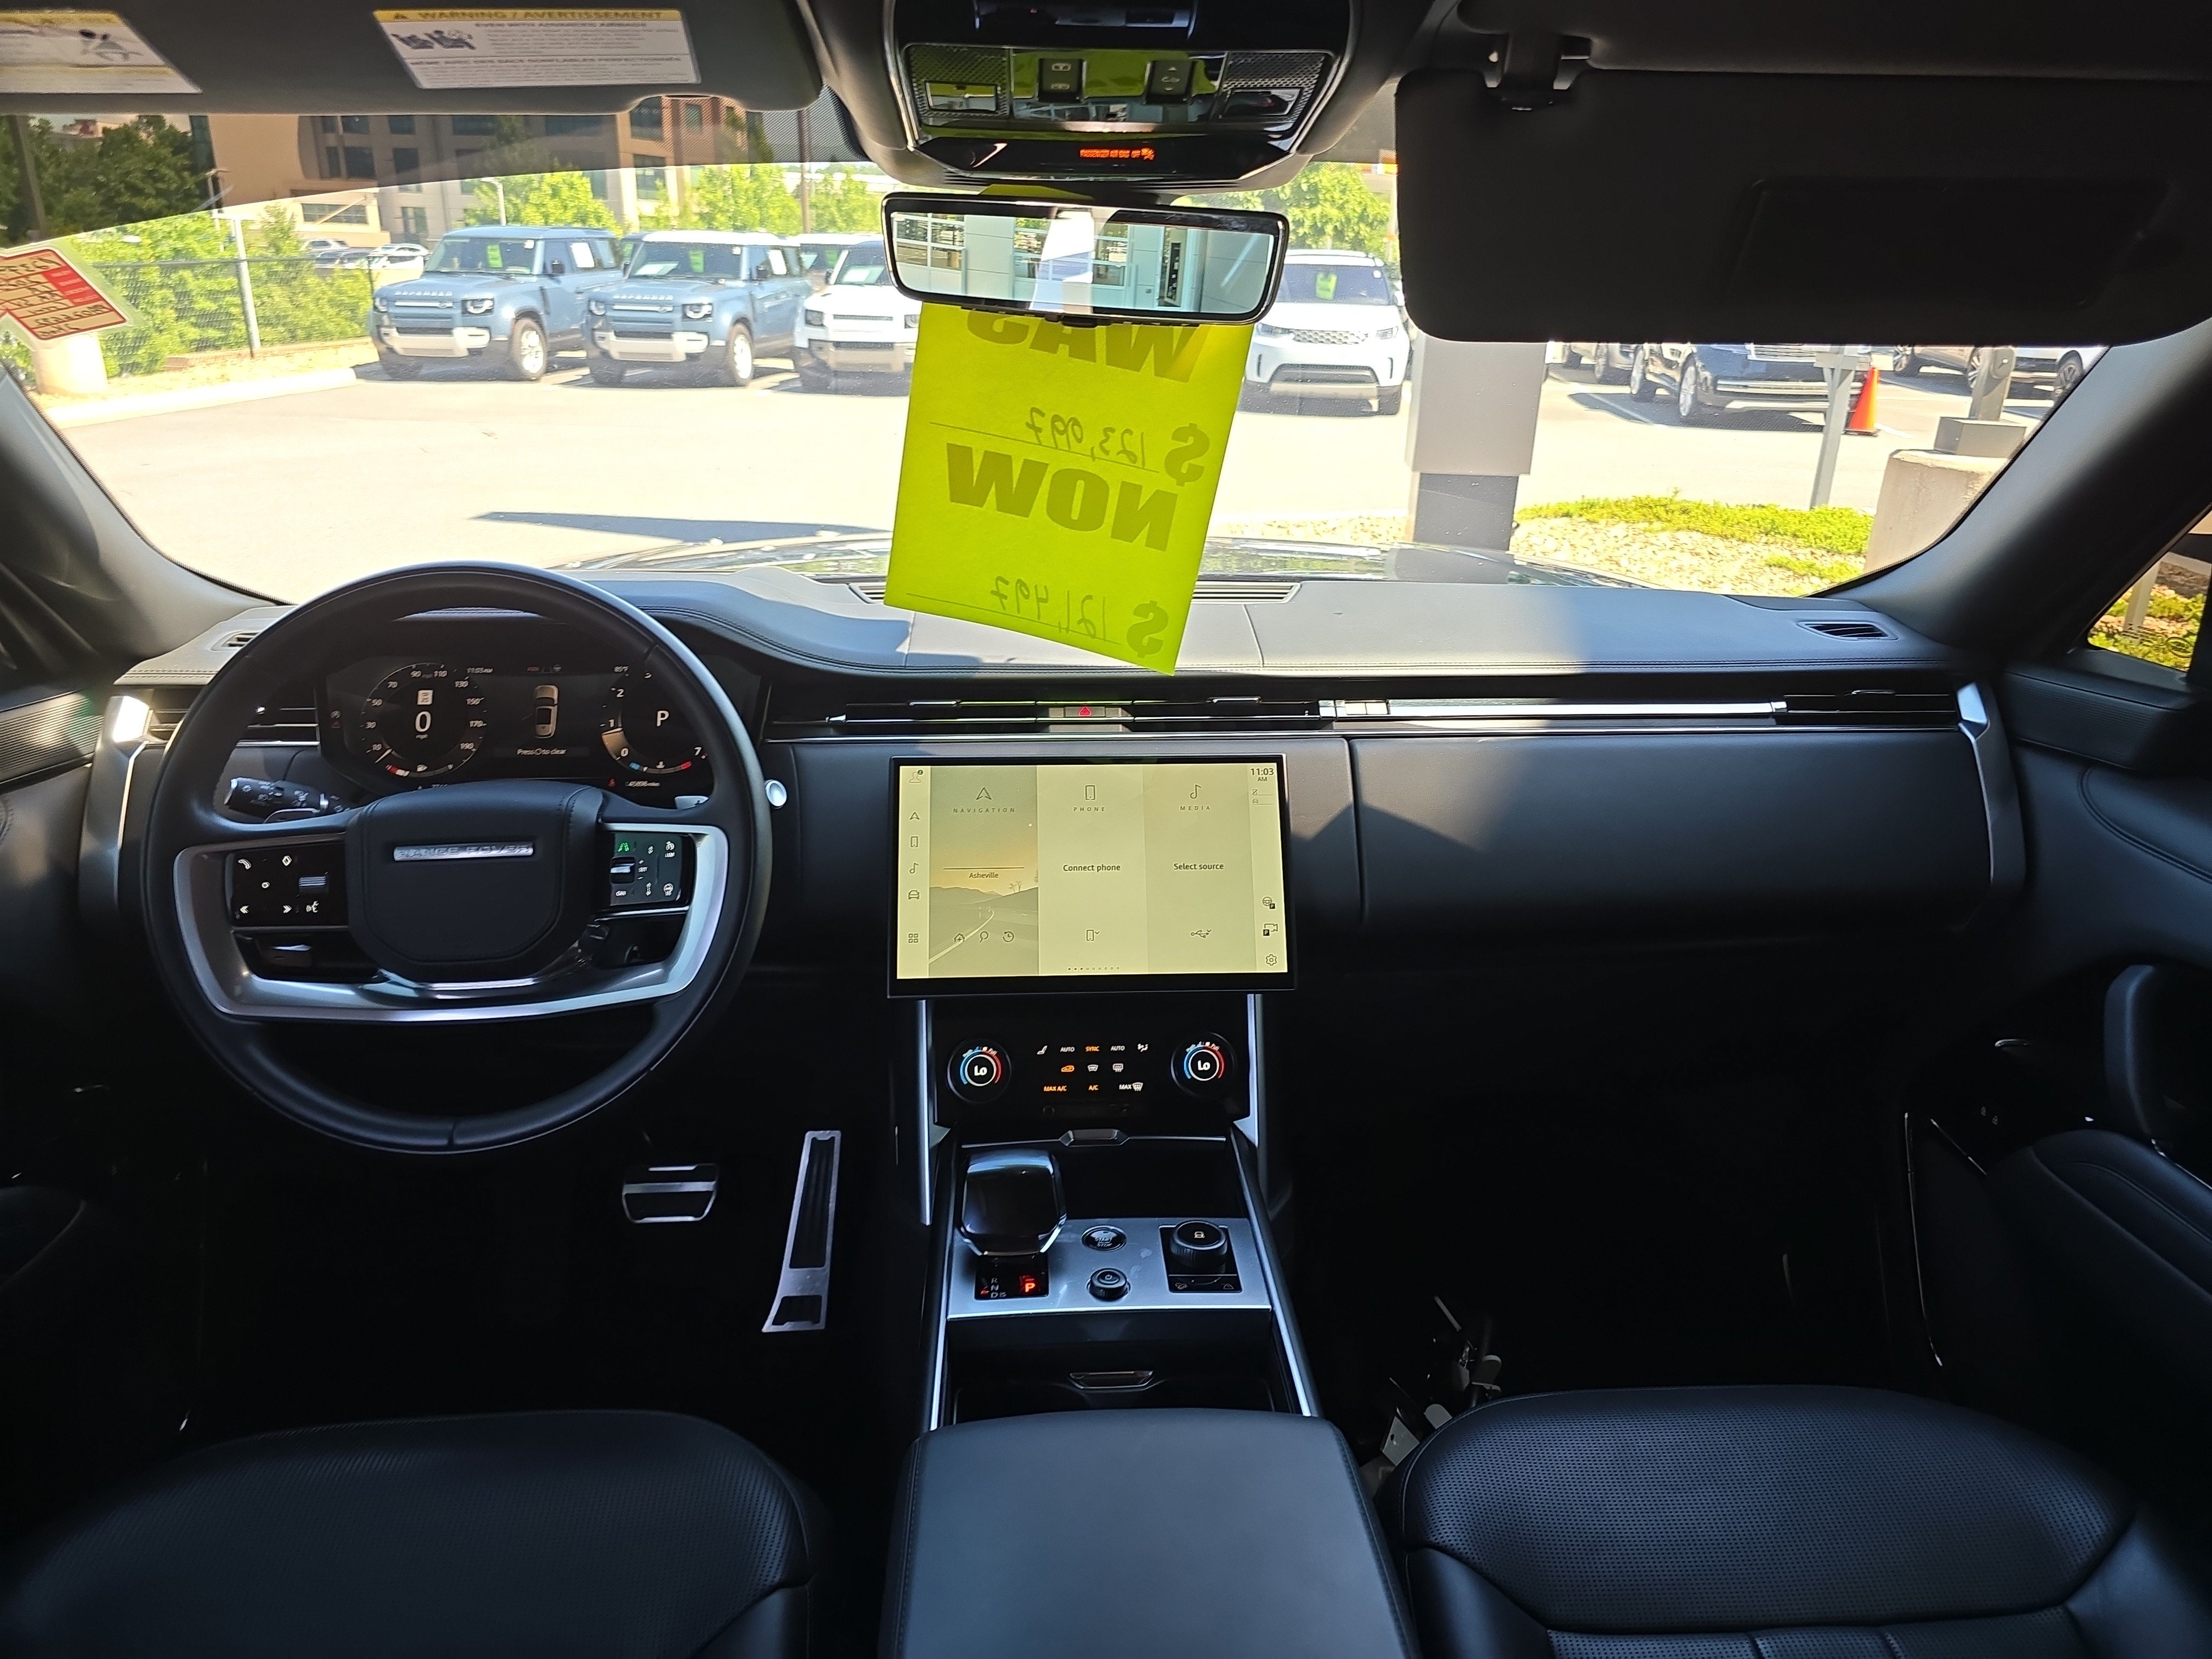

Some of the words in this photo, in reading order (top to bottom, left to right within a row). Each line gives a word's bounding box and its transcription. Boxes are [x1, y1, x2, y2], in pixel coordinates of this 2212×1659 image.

[616, 689, 624, 698] 2
[415, 711, 432, 732] 0
[657, 710, 670, 727] P
[621, 748, 629, 757] 0
[694, 747, 702, 756] 7
[1250, 768, 1275, 776] 11:03
[1097, 863, 1121, 873] phone
[1174, 863, 1197, 871] Select
[1197, 1059, 1211, 1071] Lo
[974, 1065, 987, 1076] Lo
[1025, 1282, 1036, 1293] P
